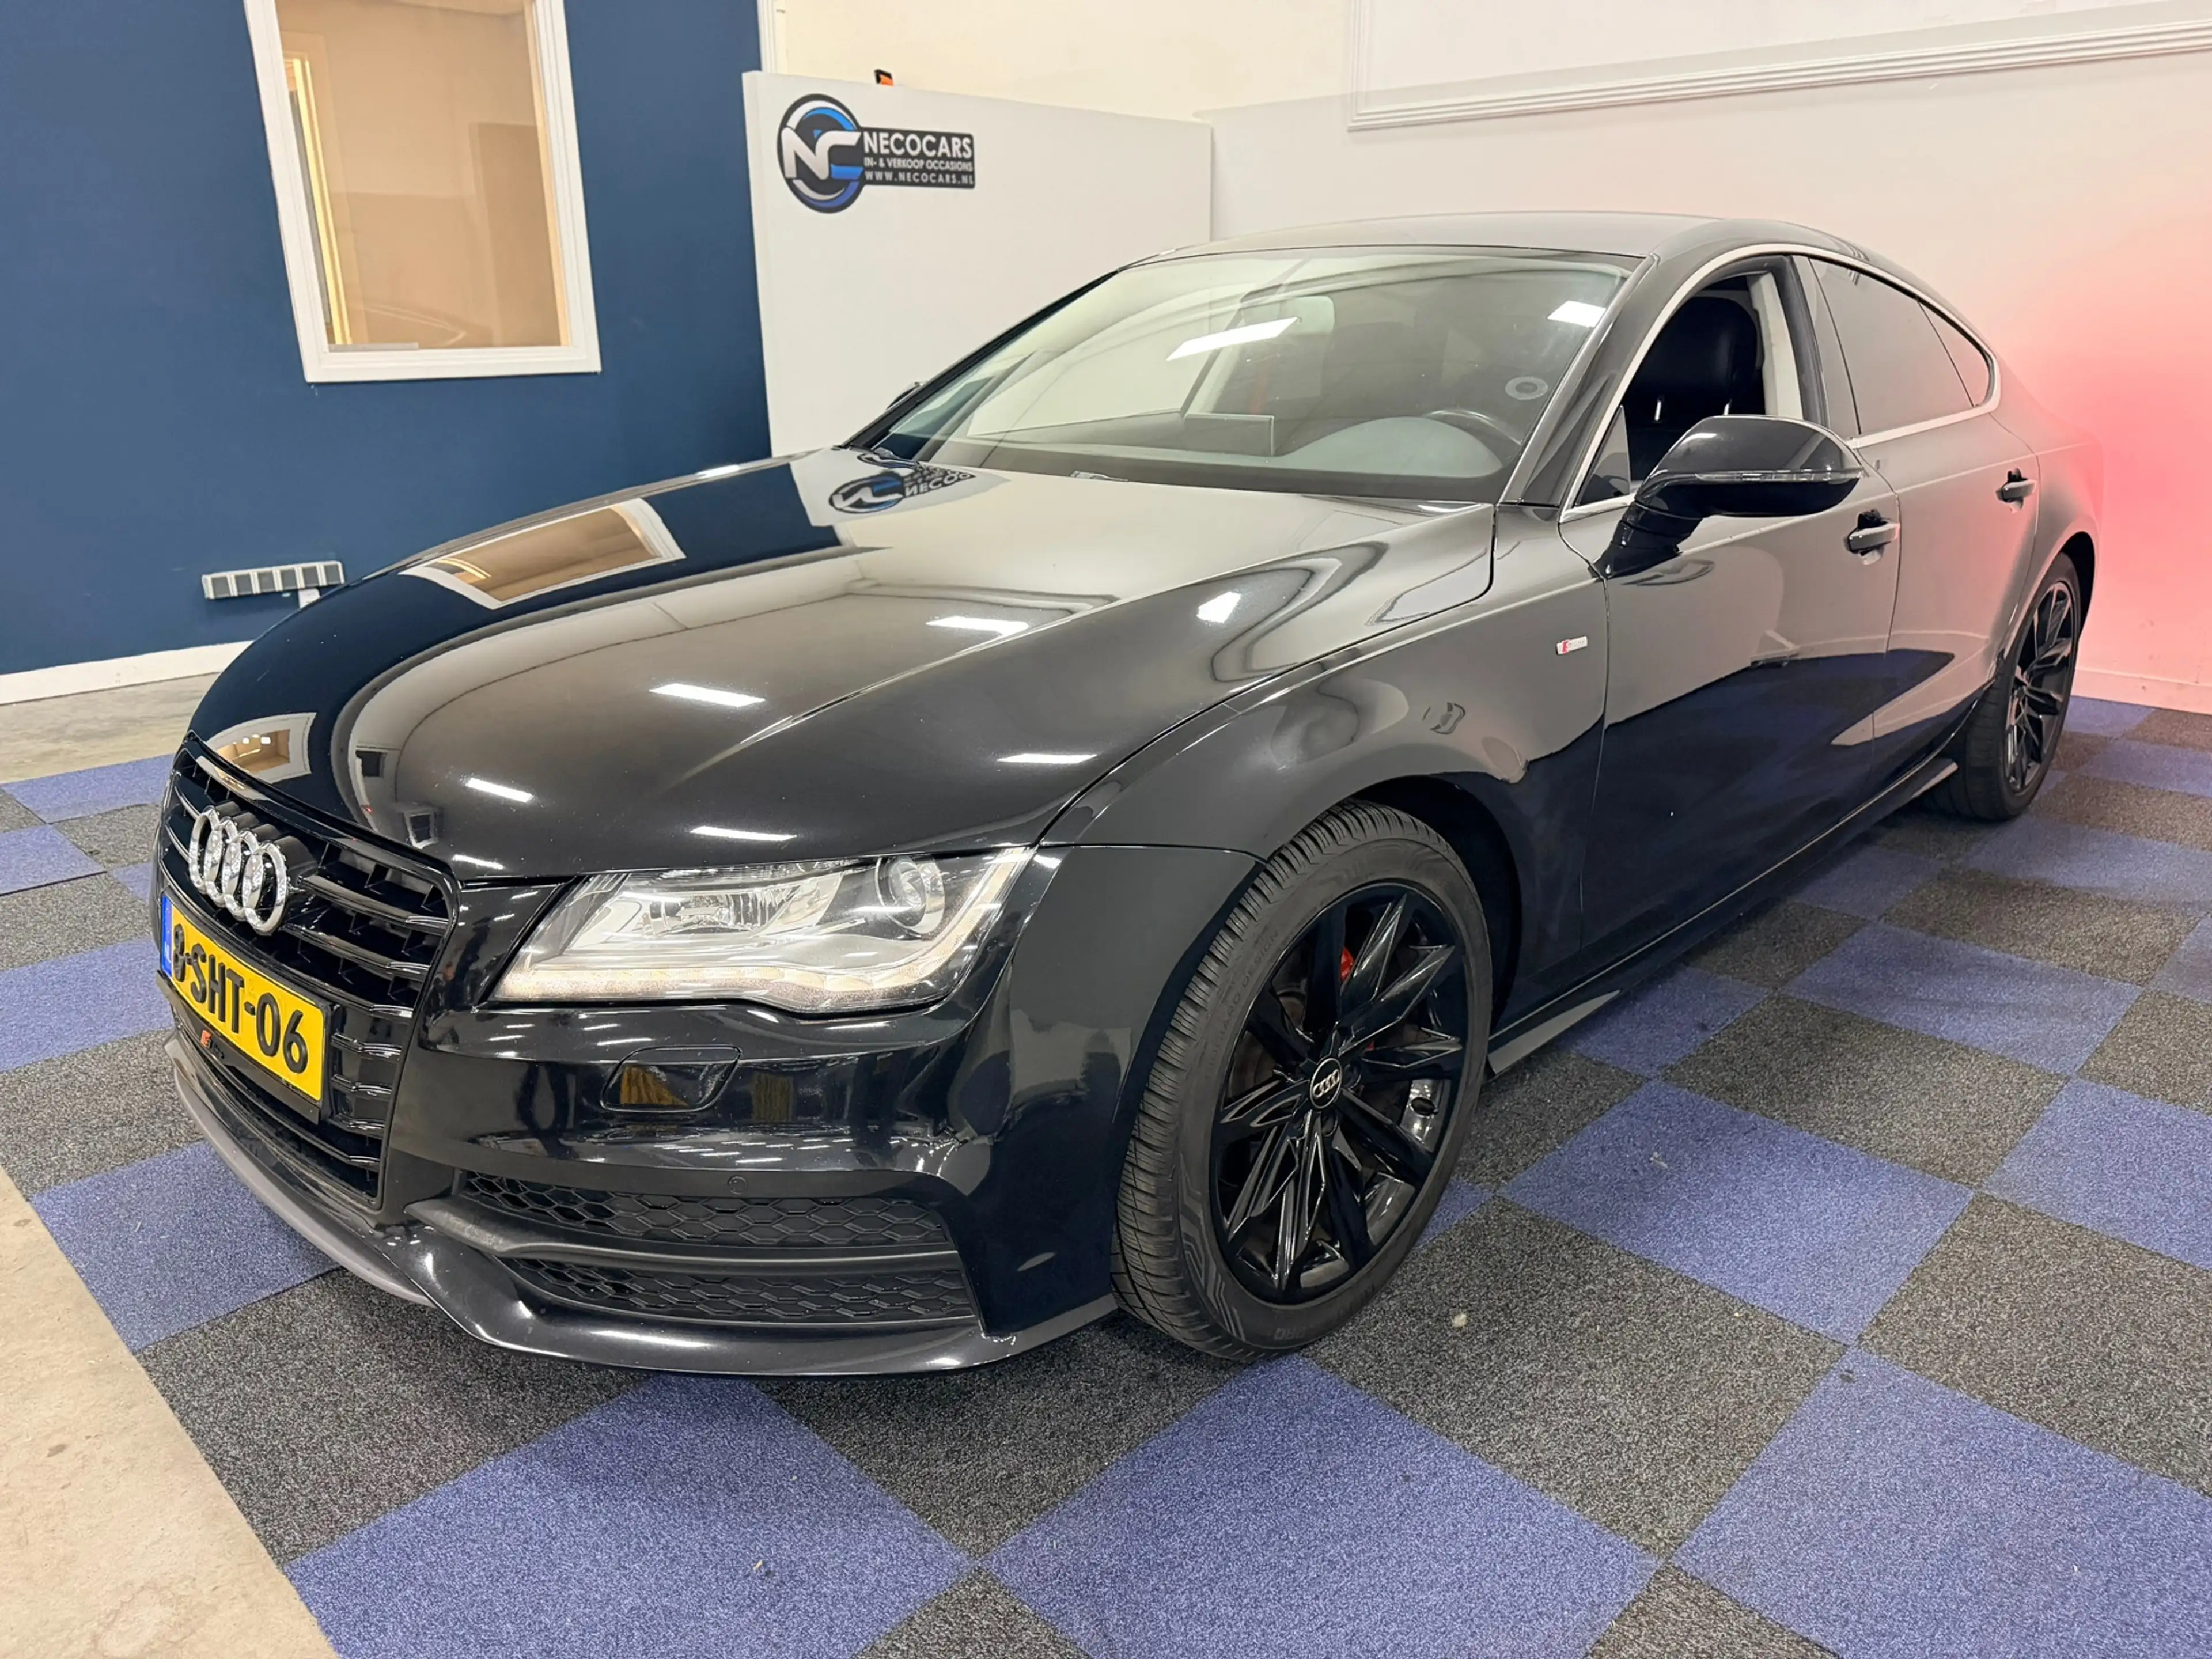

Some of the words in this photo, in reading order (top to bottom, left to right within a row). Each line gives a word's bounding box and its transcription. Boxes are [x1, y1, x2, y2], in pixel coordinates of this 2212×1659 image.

[864, 131, 972, 159] NECOCARS
[864, 157, 877, 168] IN-
[879, 158, 885, 168] &
[887, 157, 924, 169] VERKOOP
[926, 160, 973, 172] OCCASIONS
[865, 171, 974, 185] WWW.NECOCARS.NL
[173, 923, 308, 1074] 8-SHT-06
